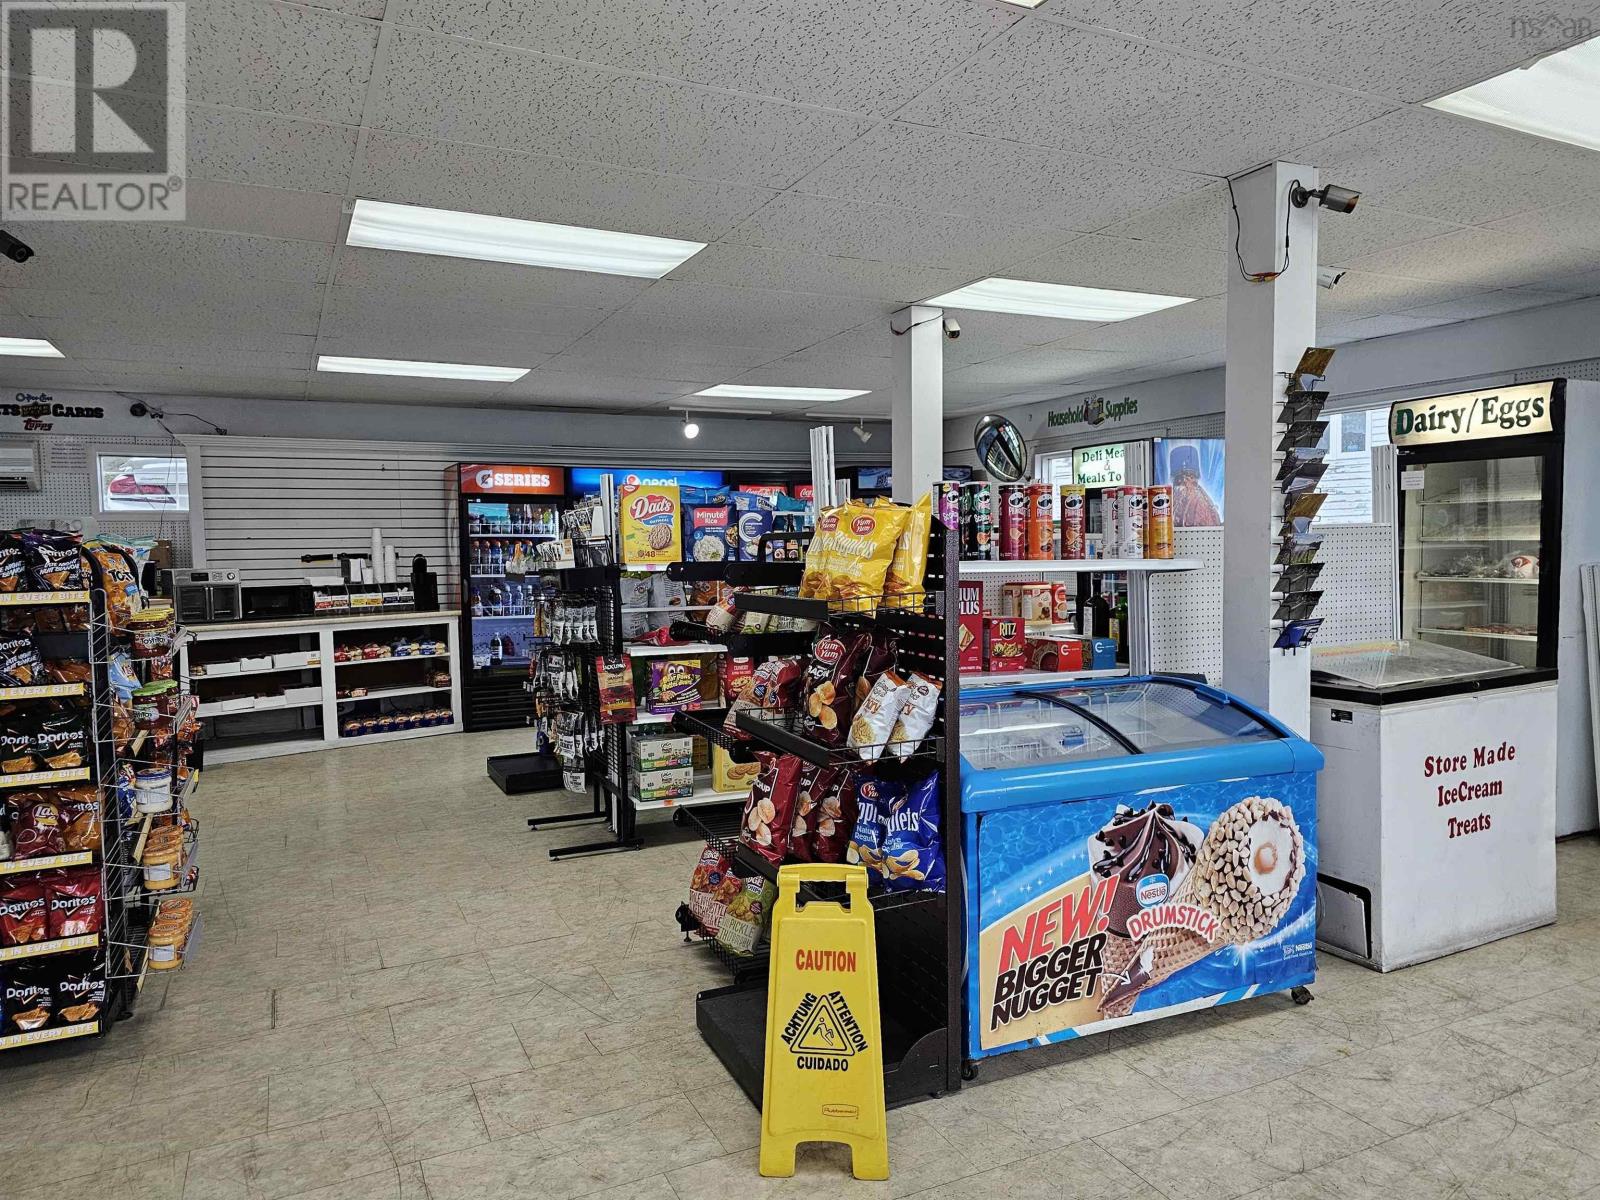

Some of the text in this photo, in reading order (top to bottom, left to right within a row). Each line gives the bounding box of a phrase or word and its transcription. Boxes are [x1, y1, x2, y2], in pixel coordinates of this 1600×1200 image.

[1047, 396, 1138, 428] Household Supplies
[1394, 396, 1545, 437] Dairy/Eggs
[1082, 450, 1102, 463] Deli
[494, 473, 551, 488] SERIES
[1077, 470, 1122, 485] Meals To
[631, 496, 672, 519] Dad's
[696, 511, 724, 520] Minute
[16, 592, 53, 600] EVERY
[59, 592, 84, 600] BITE
[1000, 622, 1016, 636] RITZ
[820, 641, 838, 650] Yum
[820, 649, 839, 659] Yum
[53, 684, 79, 692] BITE
[38, 731, 83, 743] Doritos
[1424, 741, 1515, 778] Store Made
[16, 772, 54, 781] EVERY
[59, 769, 85, 778] BITE
[1447, 812, 1491, 839] Treats
[0, 898, 45, 915] Doritos
[51, 896, 96, 910] Doritos
[999, 876, 1119, 976] NEW!
[1128, 905, 1219, 938] DRUMSTICK
[27, 943, 62, 953] EVERY
[67, 938, 94, 947] BITE
[796, 949, 856, 972] CAUTION
[993, 933, 1107, 1005] BIGGER
[6, 986, 50, 999] Doritos
[60, 980, 105, 992] Doritos
[990, 967, 1103, 1031] NUGGET
[781, 992, 818, 1045] ACHTUNG
[828, 990, 869, 1053] ATTENTION
[27, 1030, 63, 1040] EVERY
[68, 1025, 94, 1034] BITE
[797, 1056, 849, 1072] CUIDADO
